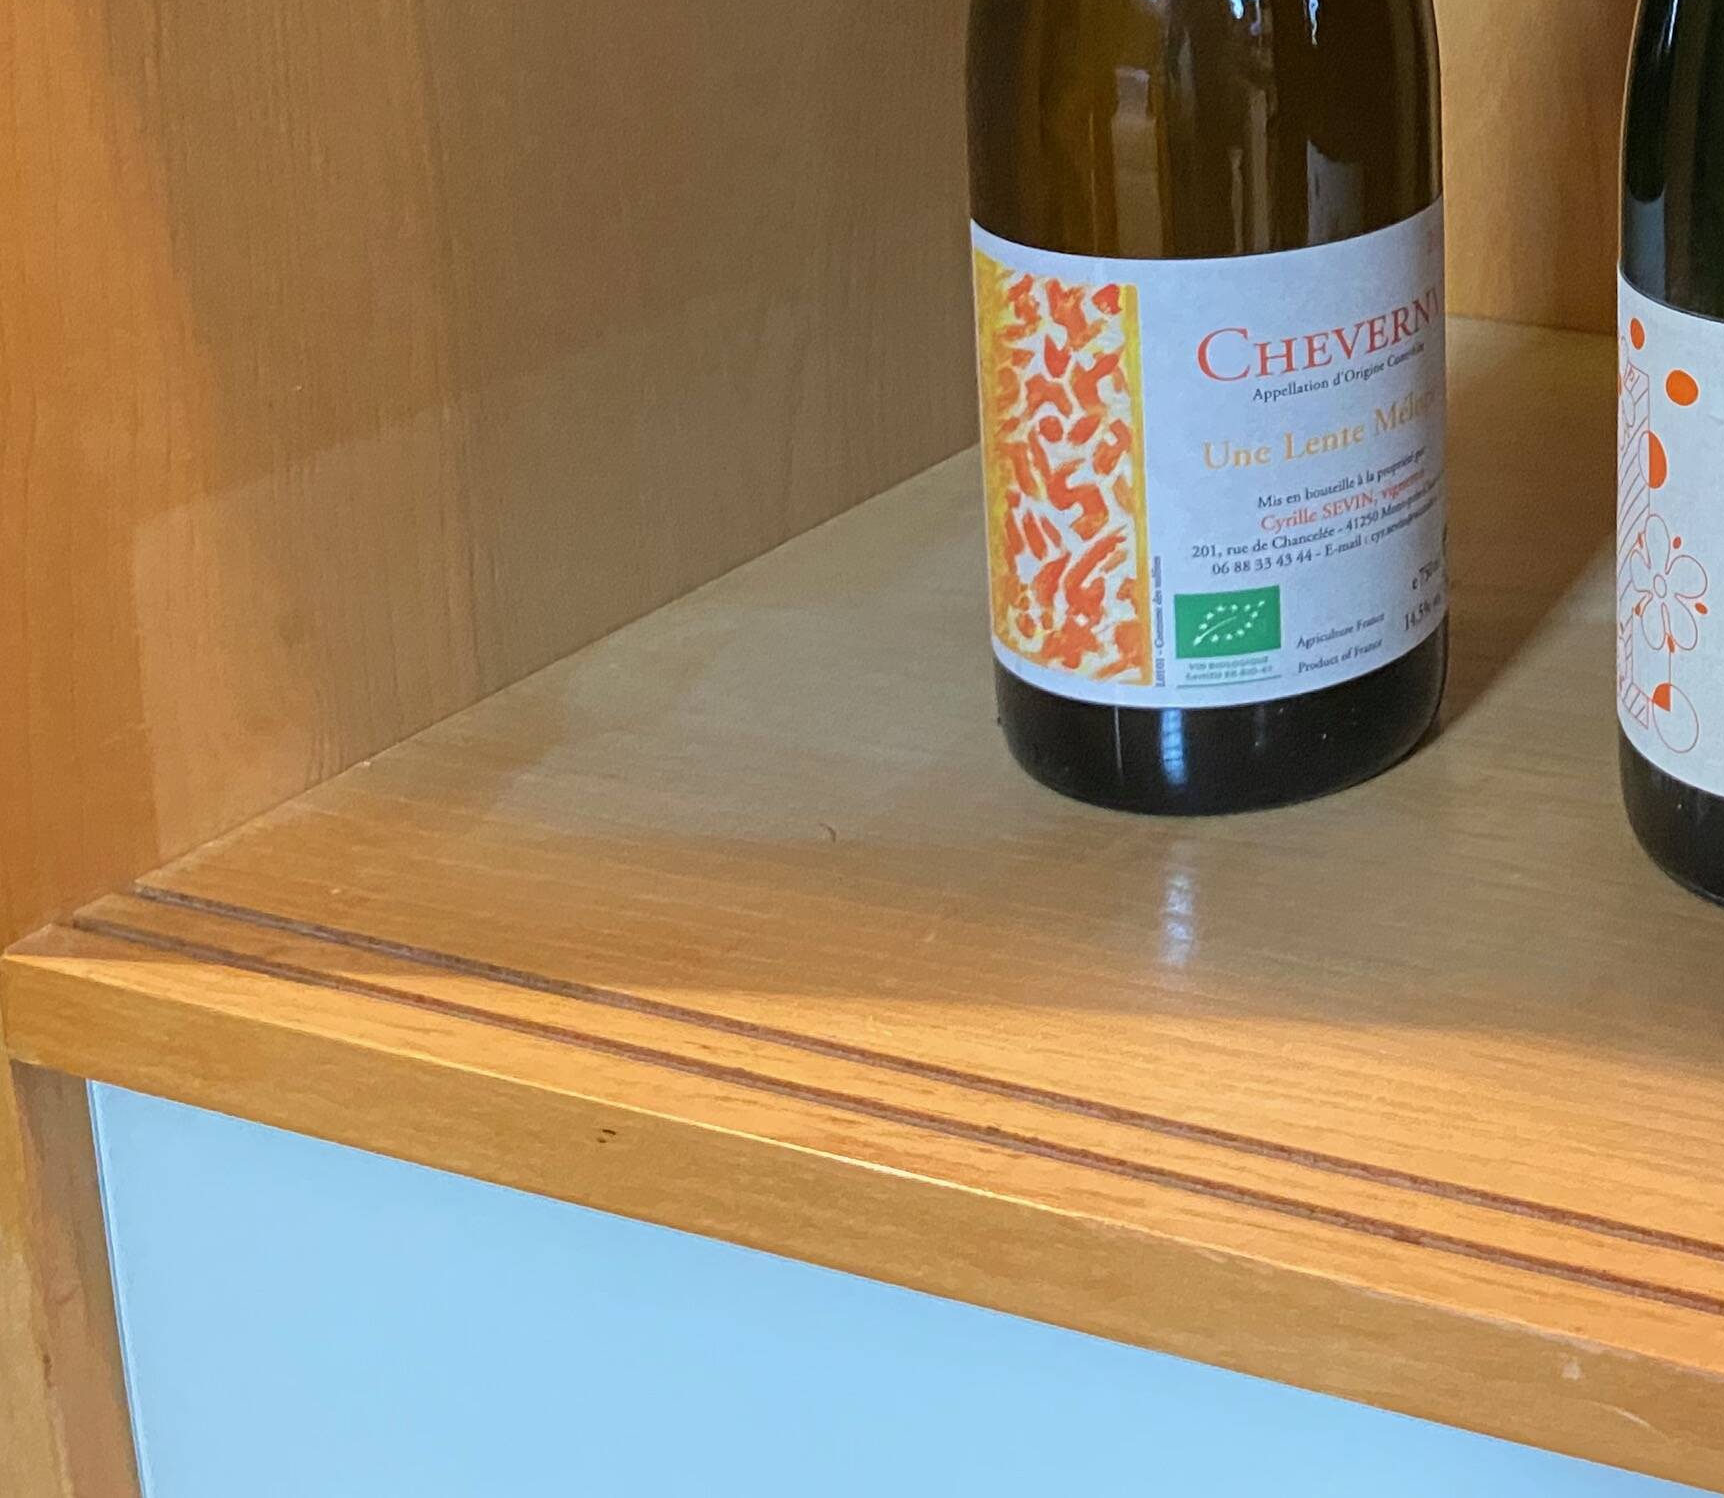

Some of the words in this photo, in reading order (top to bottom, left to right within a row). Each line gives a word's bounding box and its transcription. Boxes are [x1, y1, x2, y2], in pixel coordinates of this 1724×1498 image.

[1253, 379, 1329, 402] Appellation
[1333, 363, 1385, 386] d'Origine
[1202, 440, 1271, 471] Une
[1284, 422, 1365, 463] Lente
[1257, 494, 1283, 509] Mis
[1286, 493, 1301, 505] en
[1305, 478, 1354, 501] bouteille
[1356, 473, 1364, 486] à
[1366, 469, 1375, 484] la
[1260, 510, 1318, 534] Cyrille
[1323, 491, 1378, 520] SEVIN,
[1192, 545, 1222, 559] 201,
[1227, 544, 1249, 556] rue
[1253, 539, 1269, 552] de
[1272, 527, 1335, 550] Chancelée
[1346, 512, 1379, 533] 41250
[1212, 561, 1230, 575] 06
[1234, 558, 1251, 572] 88
[1255, 555, 1272, 571] 33
[1276, 553, 1293, 568] 43
[1296, 549, 1312, 563] 44
[1325, 535, 1362, 557] E-mail
[1298, 656, 1339, 673] Product
[1341, 647, 1351, 662] of
